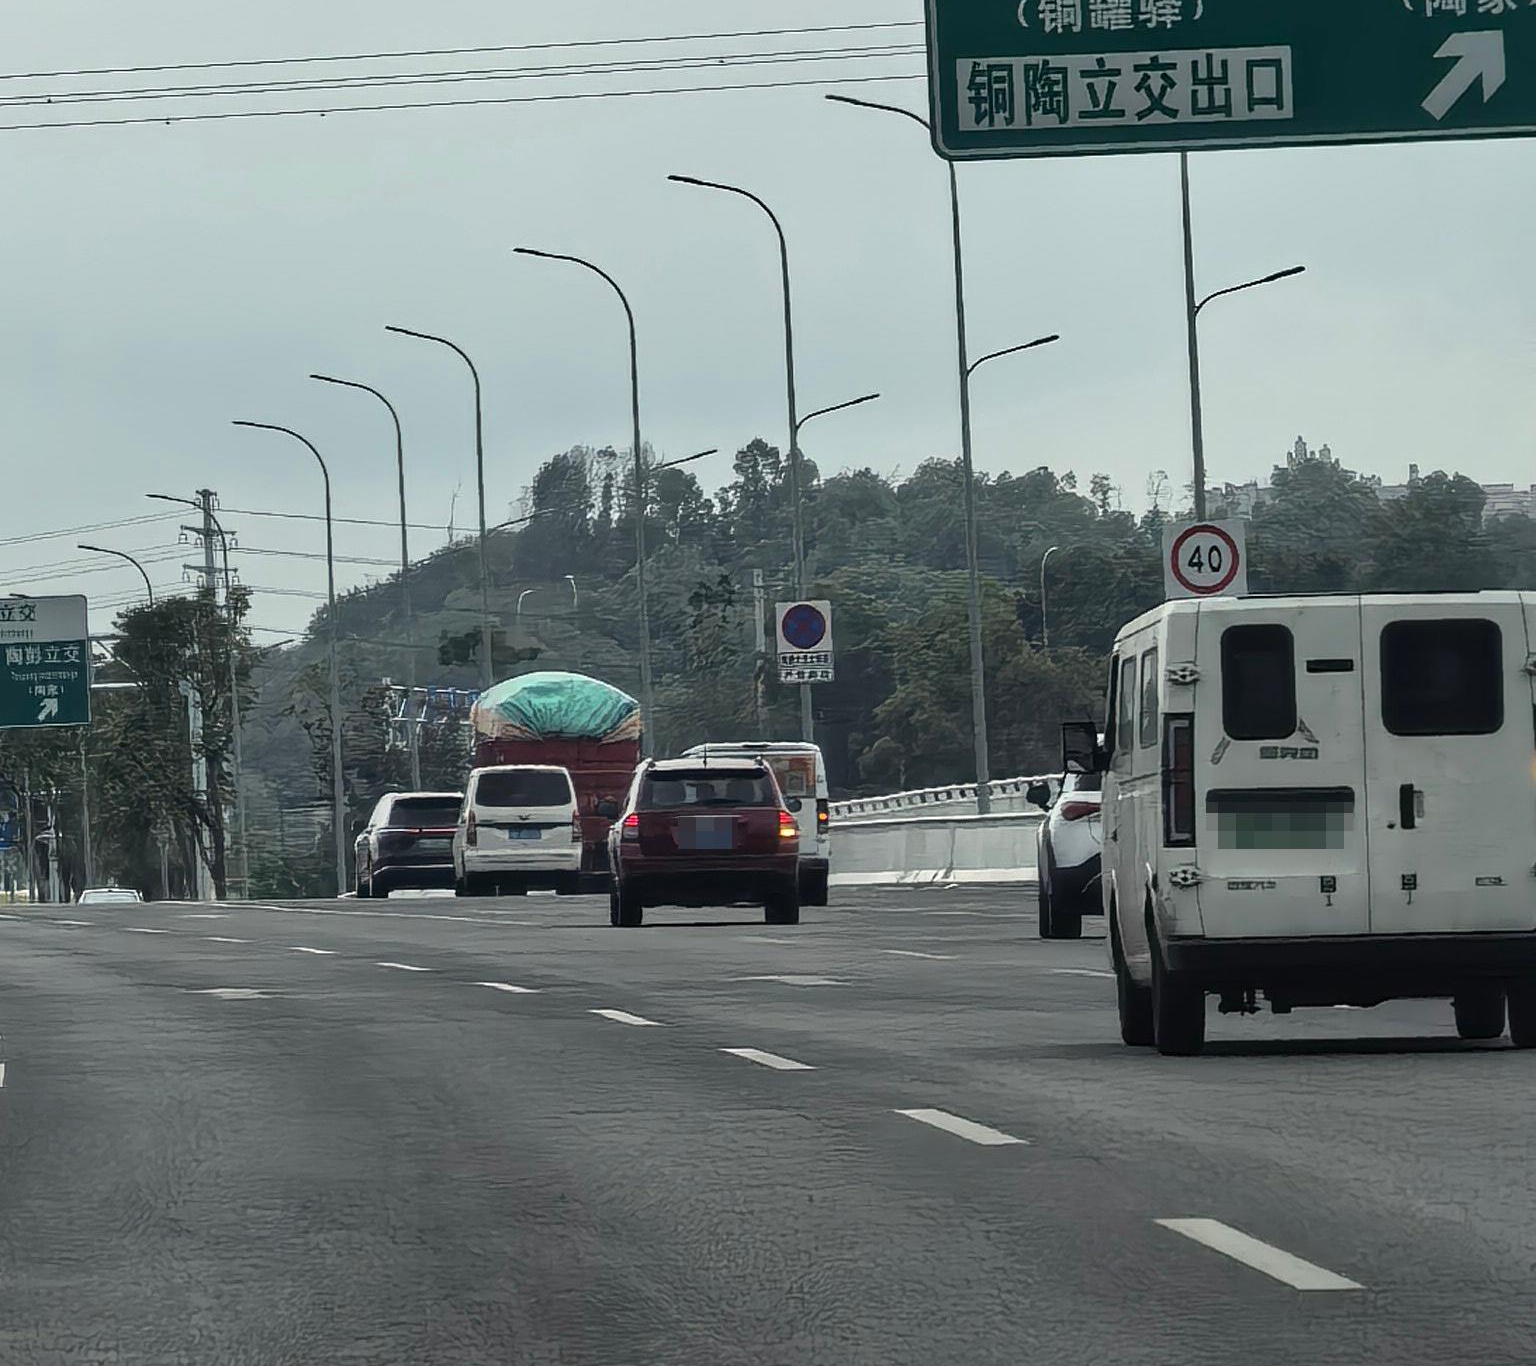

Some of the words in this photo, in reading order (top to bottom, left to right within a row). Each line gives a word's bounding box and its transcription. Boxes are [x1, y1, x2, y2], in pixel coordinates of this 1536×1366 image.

[967, 53, 1284, 127] 铜陶立交出口
[1187, 545, 1222, 573] 40
